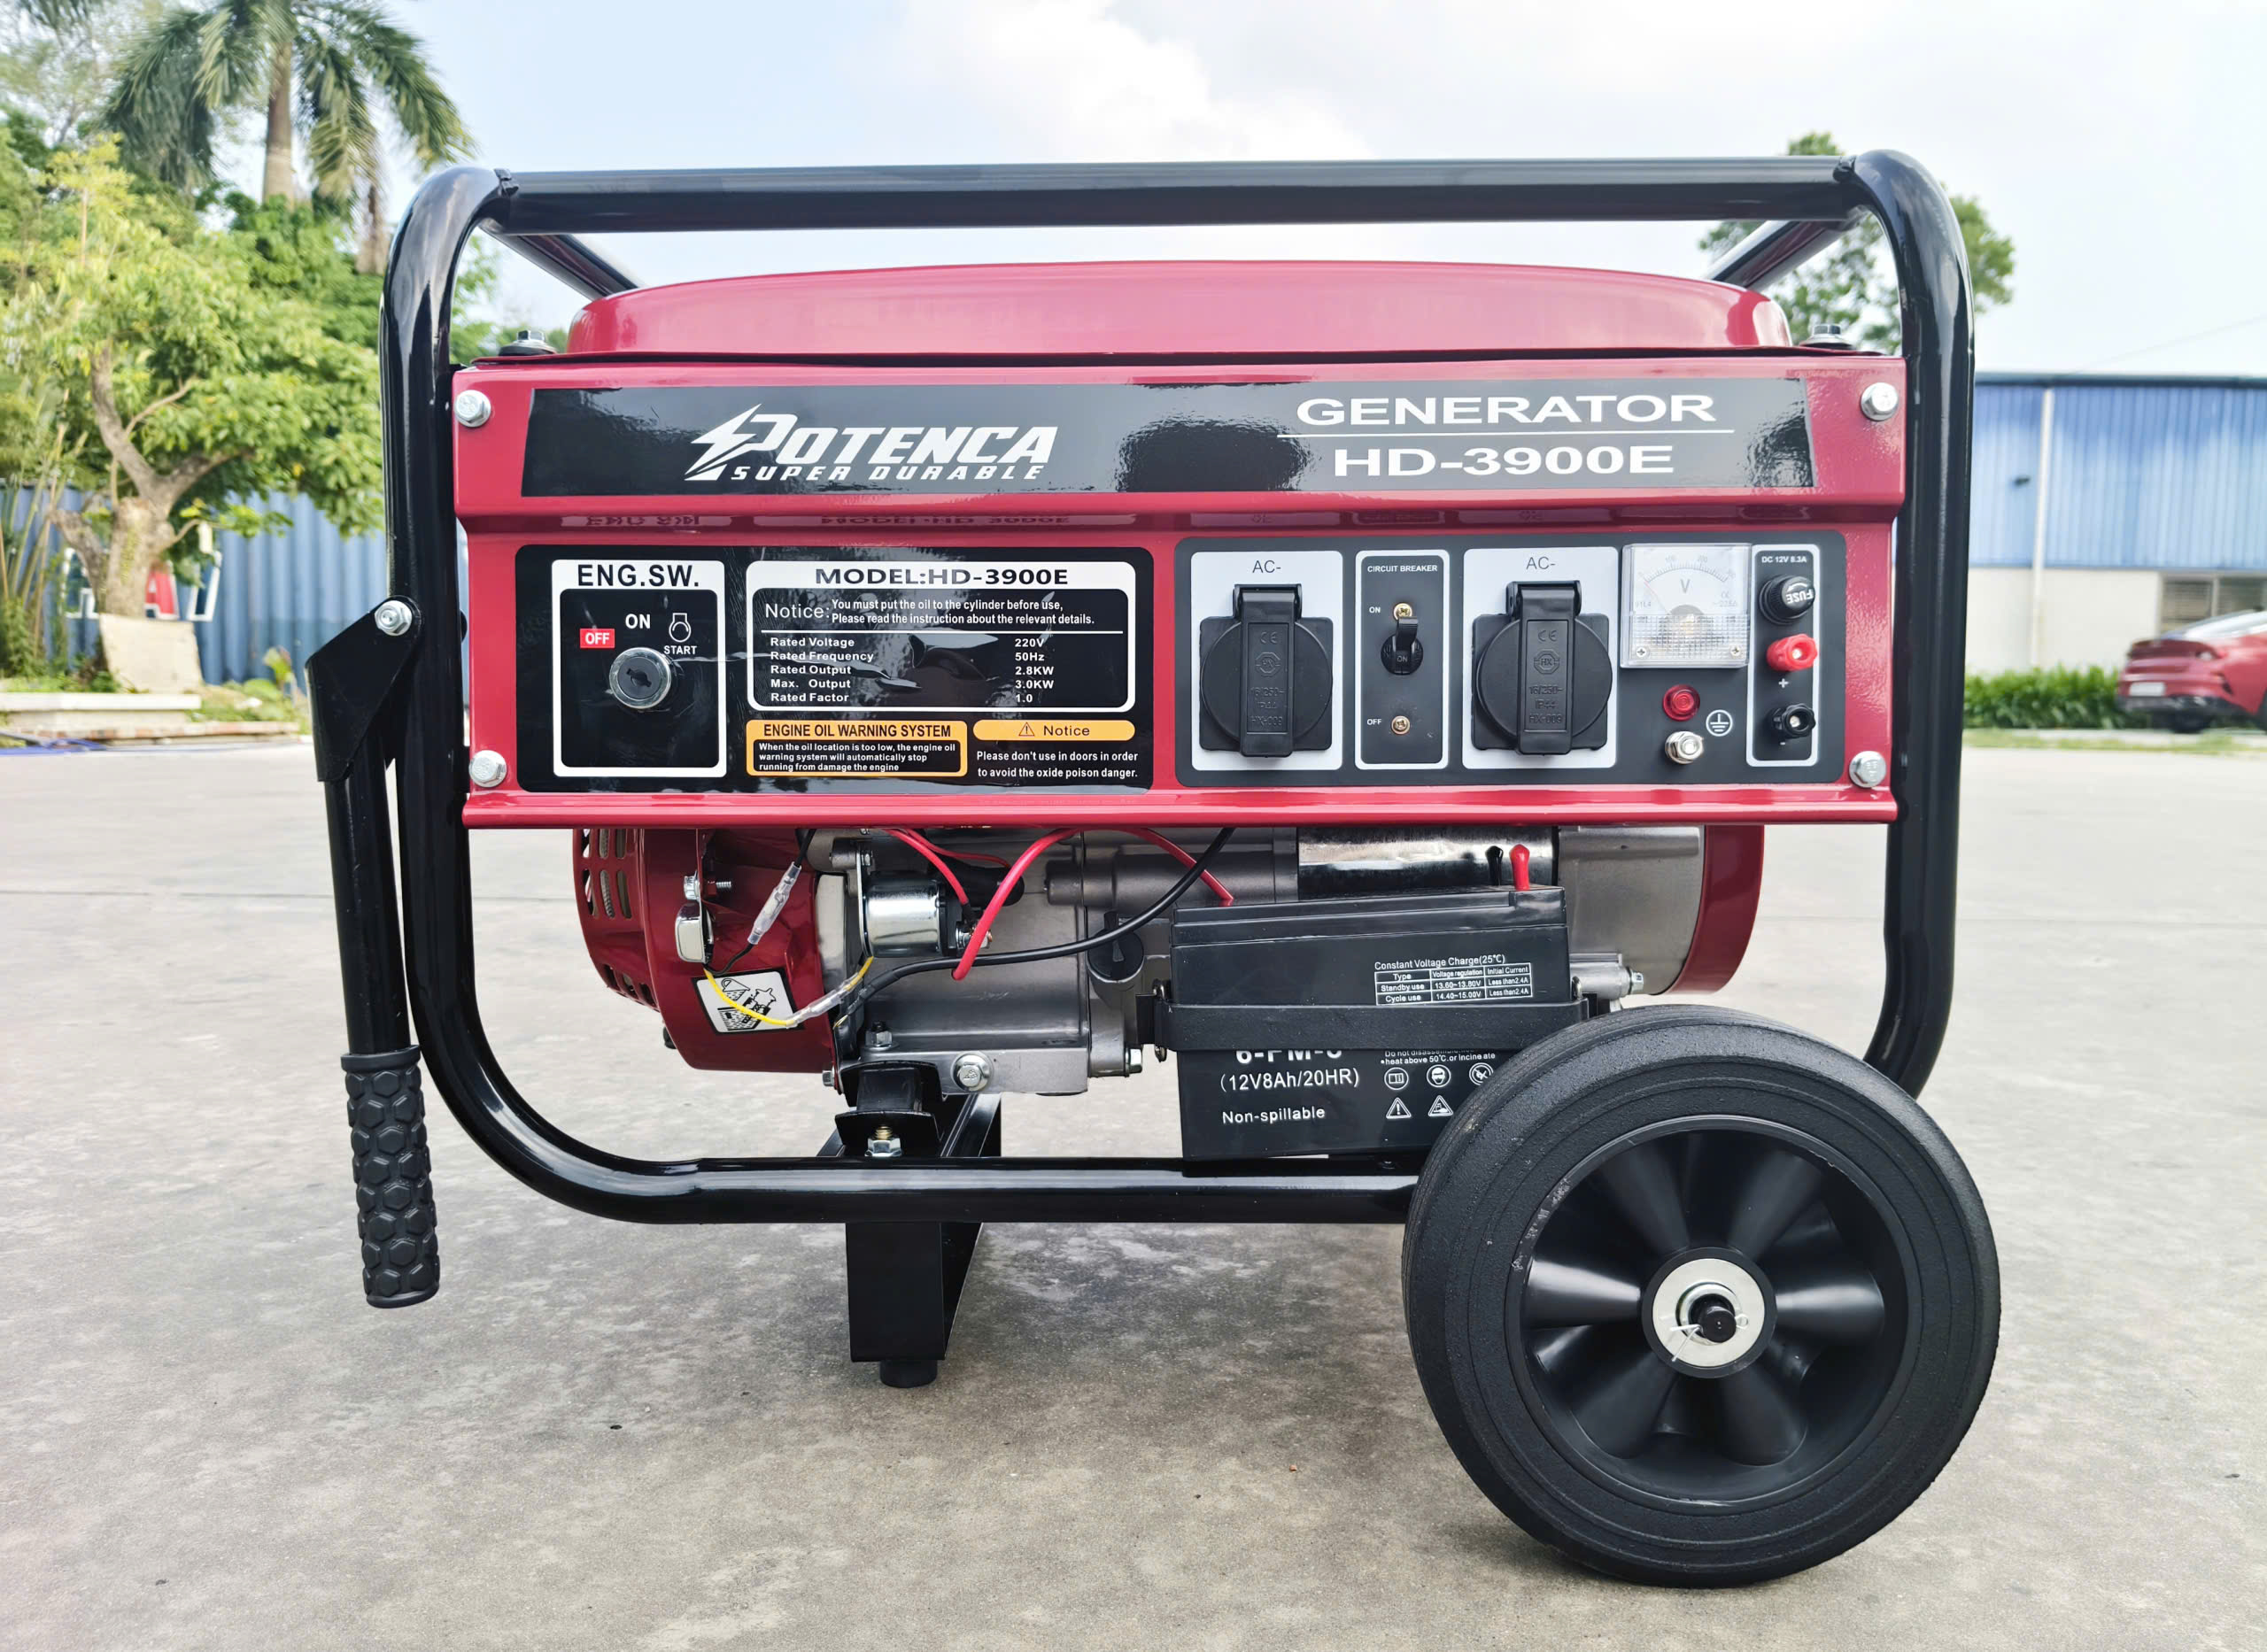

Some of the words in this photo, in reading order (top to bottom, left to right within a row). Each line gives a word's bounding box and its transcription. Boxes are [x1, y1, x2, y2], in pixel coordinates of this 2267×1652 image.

[1296, 393, 1717, 427] GENERATOR
[691, 405, 1058, 475] POTENCA
[1333, 444, 1675, 478] HD-3900E
[731, 465, 847, 481] SUPER
[869, 465, 1045, 481] DURABLE
[1400, 564, 1438, 573] BREAKER
[577, 564, 700, 587] ENG.SW.
[816, 568, 1068, 585] MODEL:HD-3900E
[1680, 579, 1691, 594] V
[1785, 589, 1814, 604] FUSE
[765, 603, 831, 619] Notice:
[832, 599, 851, 610] You
[853, 599, 878, 610] must
[881, 600, 897, 612] put
[900, 599, 916, 610] the
[918, 599, 931, 610] oil
[932, 600, 942, 610] to
[945, 599, 962, 610] the
[963, 599, 1005, 613] cylinder
[1007, 599, 1040, 610] before
[1041, 601, 1064, 613] use,
[625, 614, 651, 629] ON
[832, 613, 865, 624] Please
[867, 613, 890, 624] read
[891, 613, 908, 624] the
[910, 613, 964, 624] instruction
[966, 614, 995, 624] about
[997, 614, 1014, 624] the
[1016, 614, 1056, 624] relevant
[1058, 614, 1095, 624] details.
[584, 632, 610, 645] OFF
[770, 637, 806, 647] Rated
[809, 637, 855, 649] Voltage
[1015, 637, 1045, 647] 220V
[664, 645, 698, 655] START
[770, 651, 806, 660] Rated
[809, 651, 874, 663] Frequency
[1015, 652, 1045, 661] 50Hz
[770, 665, 806, 675] Rated
[809, 665, 852, 676] Output
[1015, 666, 1055, 675] 2.8KW
[770, 678, 800, 688] Max.
[809, 678, 851, 690] Output
[1015, 679, 1055, 689] 3.0KW
[770, 692, 807, 702] Rated
[809, 692, 849, 702] Factor
[1016, 693, 1033, 703] 1.0
[763, 723, 810, 737] ENGINE
[814, 724, 835, 737] OIL
[838, 724, 897, 737] WARNING
[901, 724, 951, 737] SYSTEM
[1043, 725, 1090, 737] Notice
[759, 742, 784, 751] When
[785, 742, 800, 751] the
[801, 742, 813, 751] oil
[814, 743, 850, 752] location
[851, 743, 860, 752] is
[862, 743, 877, 752] too
[878, 743, 895, 753] low,
[913, 744, 942, 753] engine
[759, 753, 794, 762] warning
[796, 753, 828, 762] system
[847, 753, 906, 762] automatically
[908, 753, 928, 762] stop
[977, 751, 1010, 760] Please
[1011, 751, 1037, 760] don't
[1058, 752, 1067, 760] in
[1070, 752, 1098, 760] doors
[1100, 752, 1109, 760] in
[1111, 752, 1139, 760] order
[759, 763, 793, 772] running
[795, 762, 816, 771] from
[817, 762, 853, 772] damage
[869, 763, 900, 772] engine
[978, 768, 988, 777] to
[989, 768, 1017, 777] avoid
[1018, 768, 1034, 777] the
[1036, 768, 1064, 777] oxide
[1065, 768, 1100, 779] poison
[1101, 768, 1139, 779] danger.
[1374, 960, 1413, 970] Constant
[1416, 957, 1446, 969] Voltage
[1454, 969, 1483, 977] regulation
[1381, 984, 1411, 992] Standby
[1219, 1067, 1360, 1092] (12V8Ah/20HR)
[1222, 1106, 1326, 1124] Non-spillable
